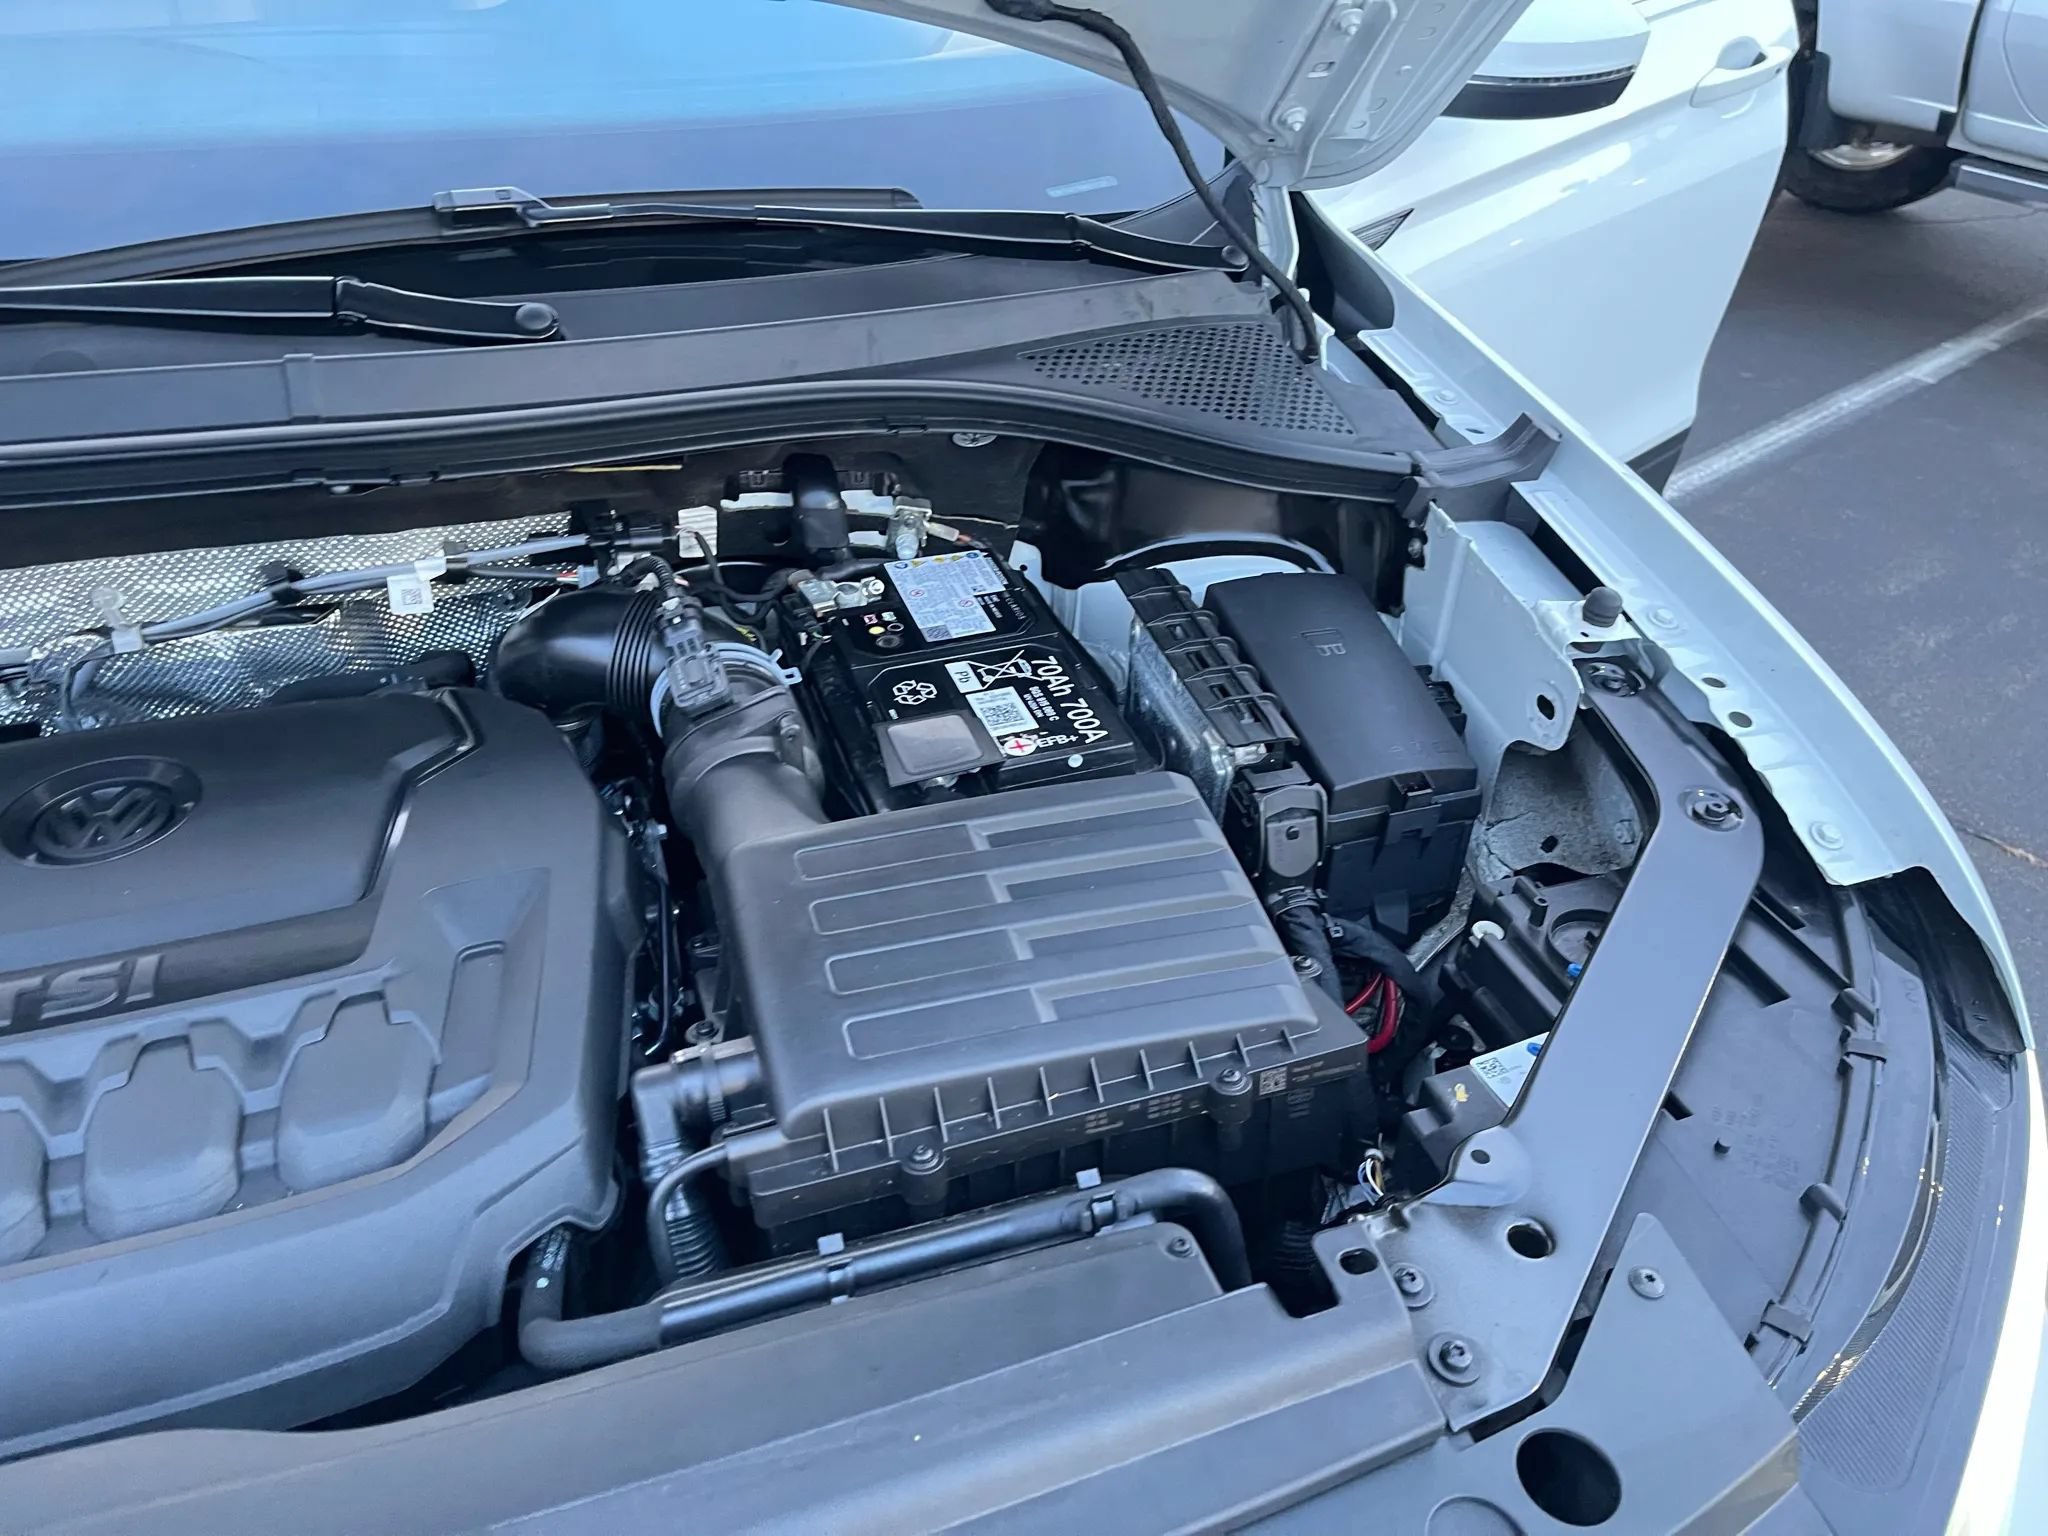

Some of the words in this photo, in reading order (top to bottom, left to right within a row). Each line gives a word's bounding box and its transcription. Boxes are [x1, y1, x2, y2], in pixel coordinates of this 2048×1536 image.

[954, 670, 970, 683] Pb
[1031, 655, 1075, 697] 70Ah
[1060, 697, 1108, 744] 700A
